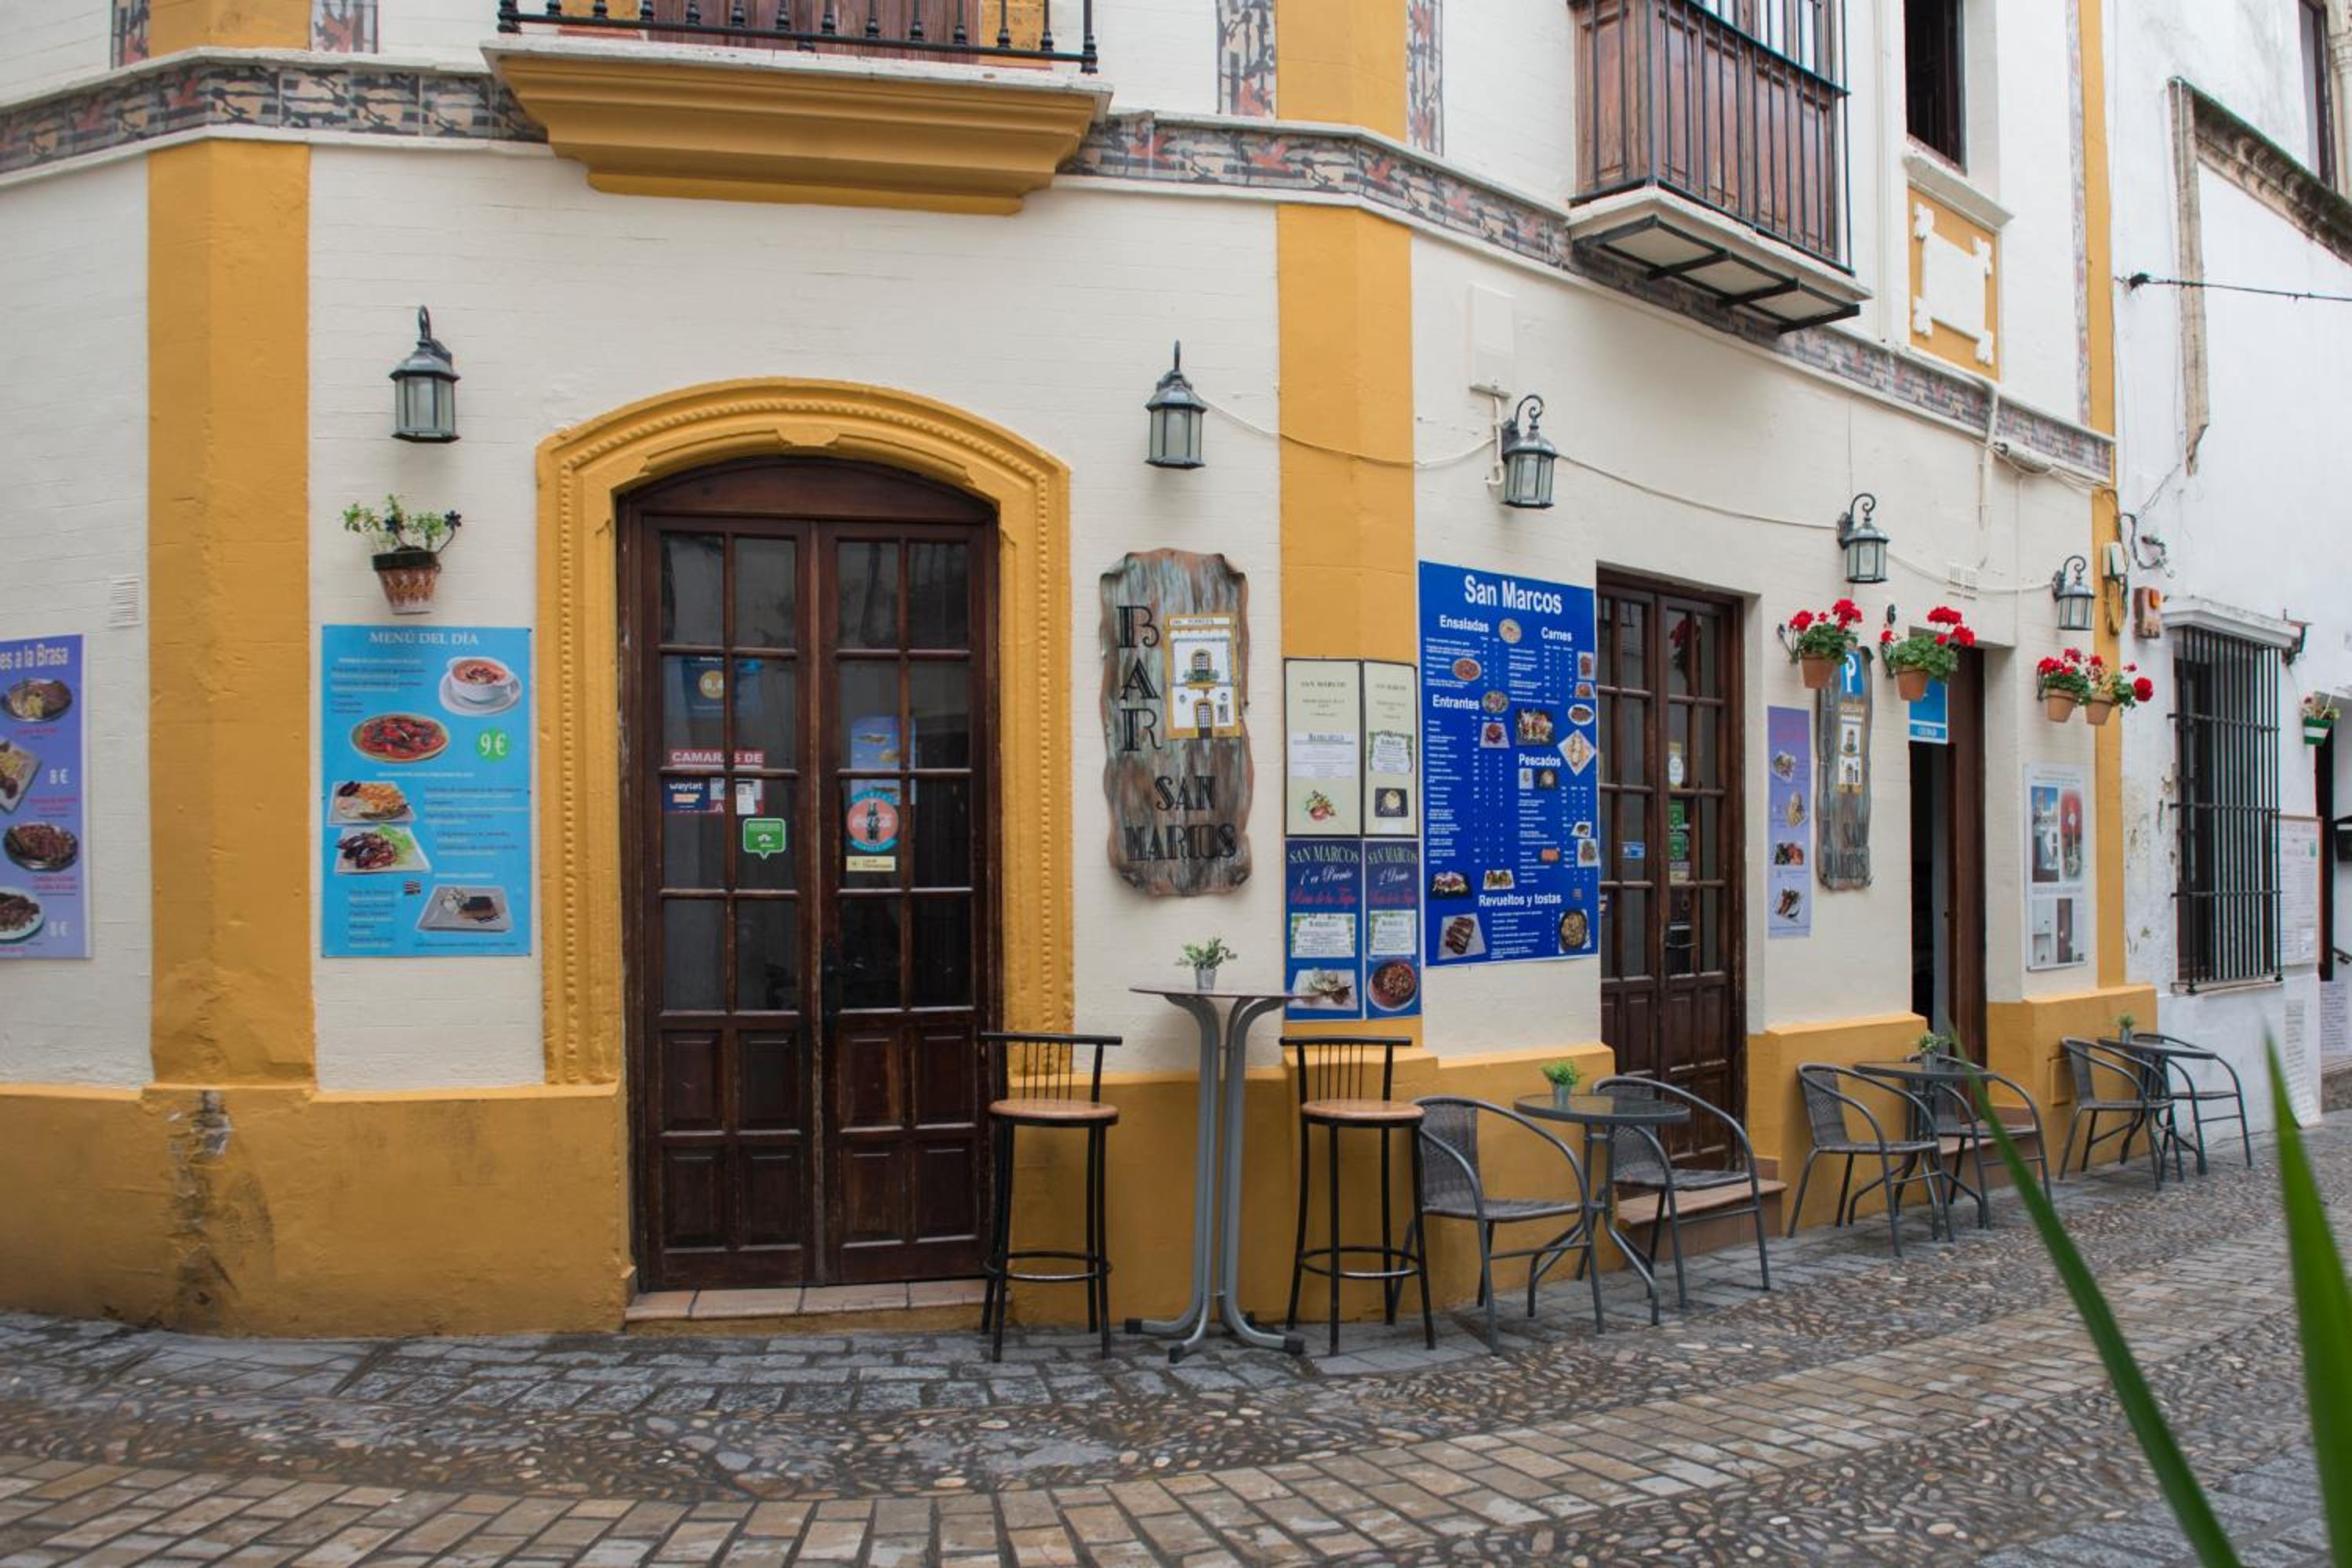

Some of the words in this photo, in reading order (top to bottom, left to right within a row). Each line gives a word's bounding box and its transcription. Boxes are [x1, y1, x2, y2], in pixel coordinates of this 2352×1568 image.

[1465, 575, 1497, 606] San
[1501, 580, 1563, 615] Marcos
[419, 633, 448, 644] DEL
[1541, 626, 1572, 642] Carnes
[38, 644, 68, 667] Brasa
[1116, 605, 1163, 752] BAR
[1432, 694, 1479, 710] Entrantes
[672, 752, 740, 763] CAMARS
[744, 753, 764, 763] DE
[1519, 753, 1561, 768] Pescados
[1155, 775, 1216, 811] SAN
[1526, 895, 1533, 908] y
